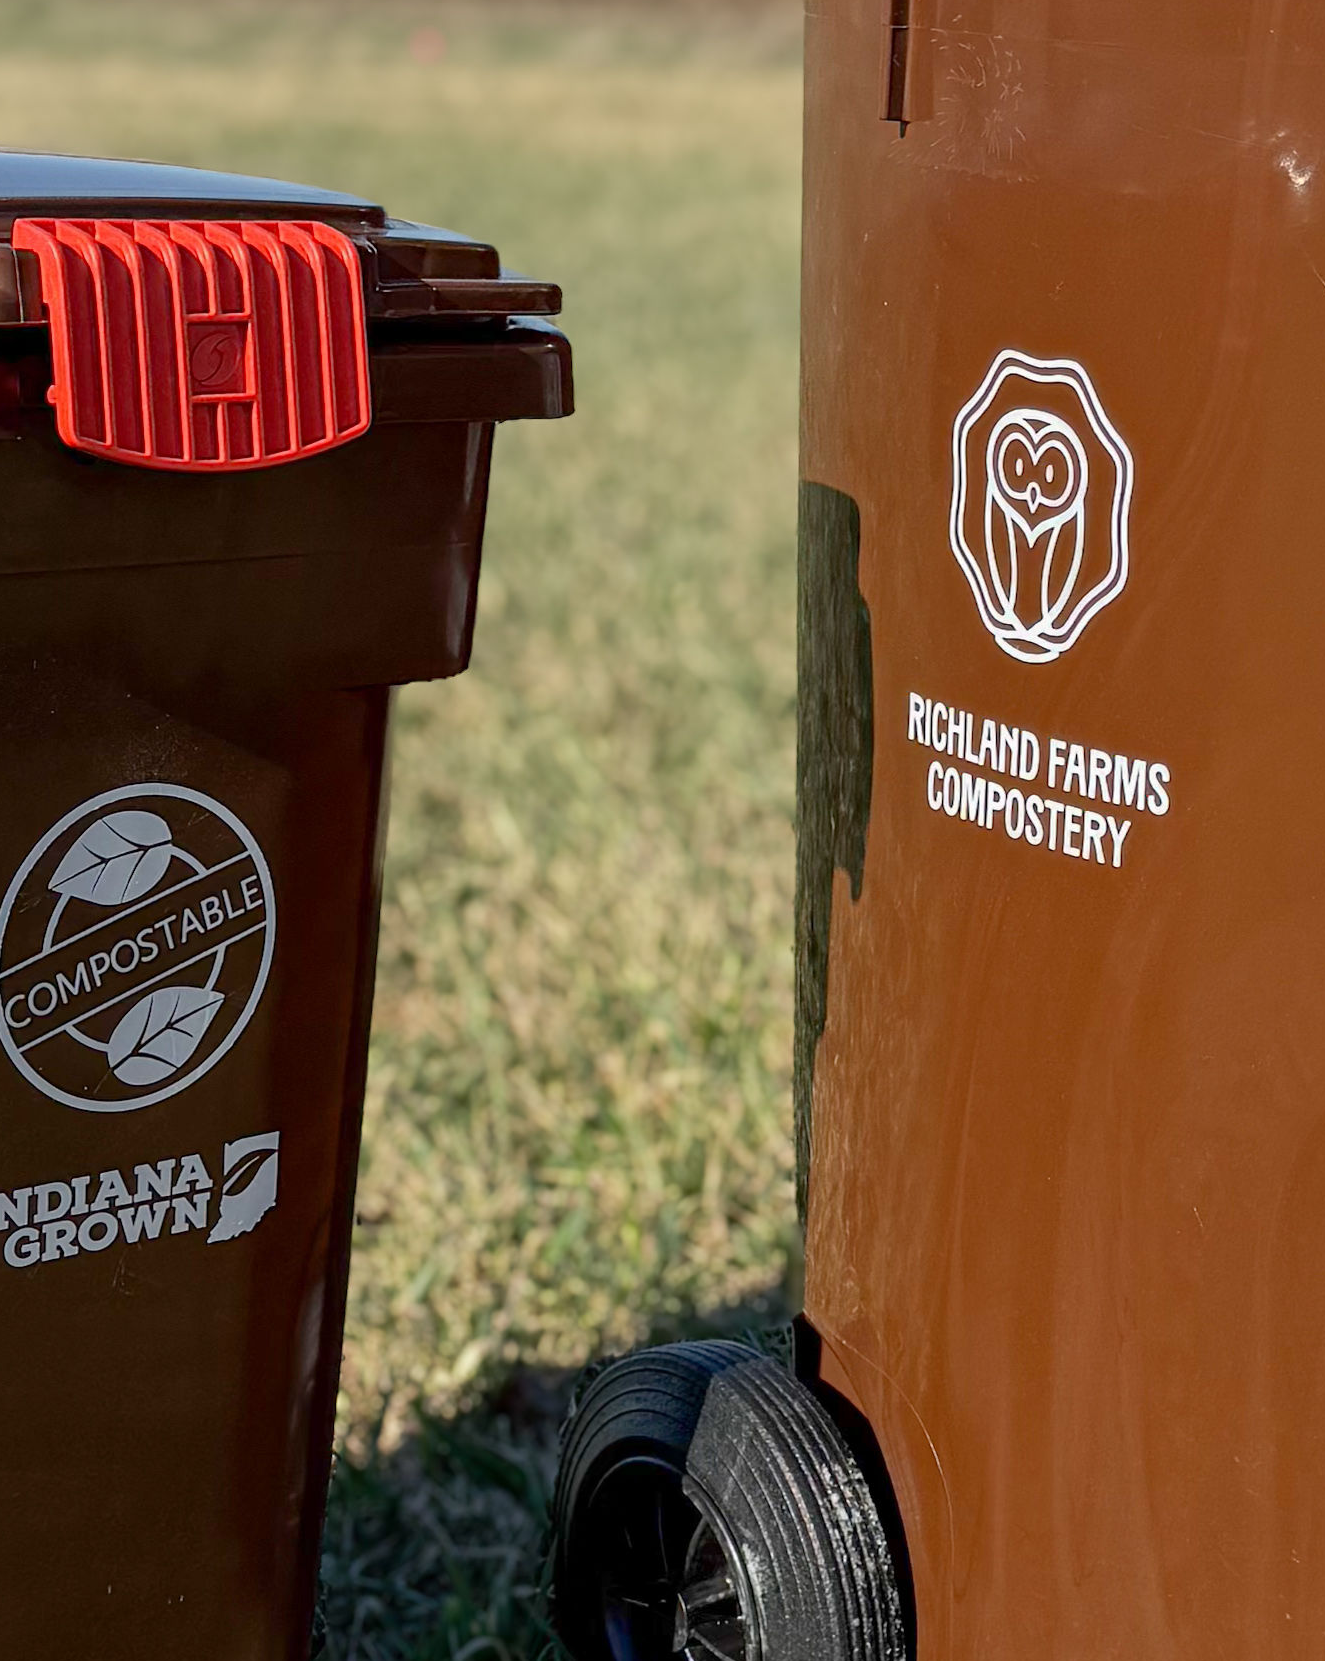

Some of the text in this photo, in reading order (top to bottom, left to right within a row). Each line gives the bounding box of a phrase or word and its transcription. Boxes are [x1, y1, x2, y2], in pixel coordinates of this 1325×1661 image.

[908, 692, 1170, 816] RICHLAND FARMS
[927, 760, 1132, 868] COMPOSTERY
[3, 873, 265, 1031] COMPOSTABLE
[2, 1191, 212, 1269] GROWN
